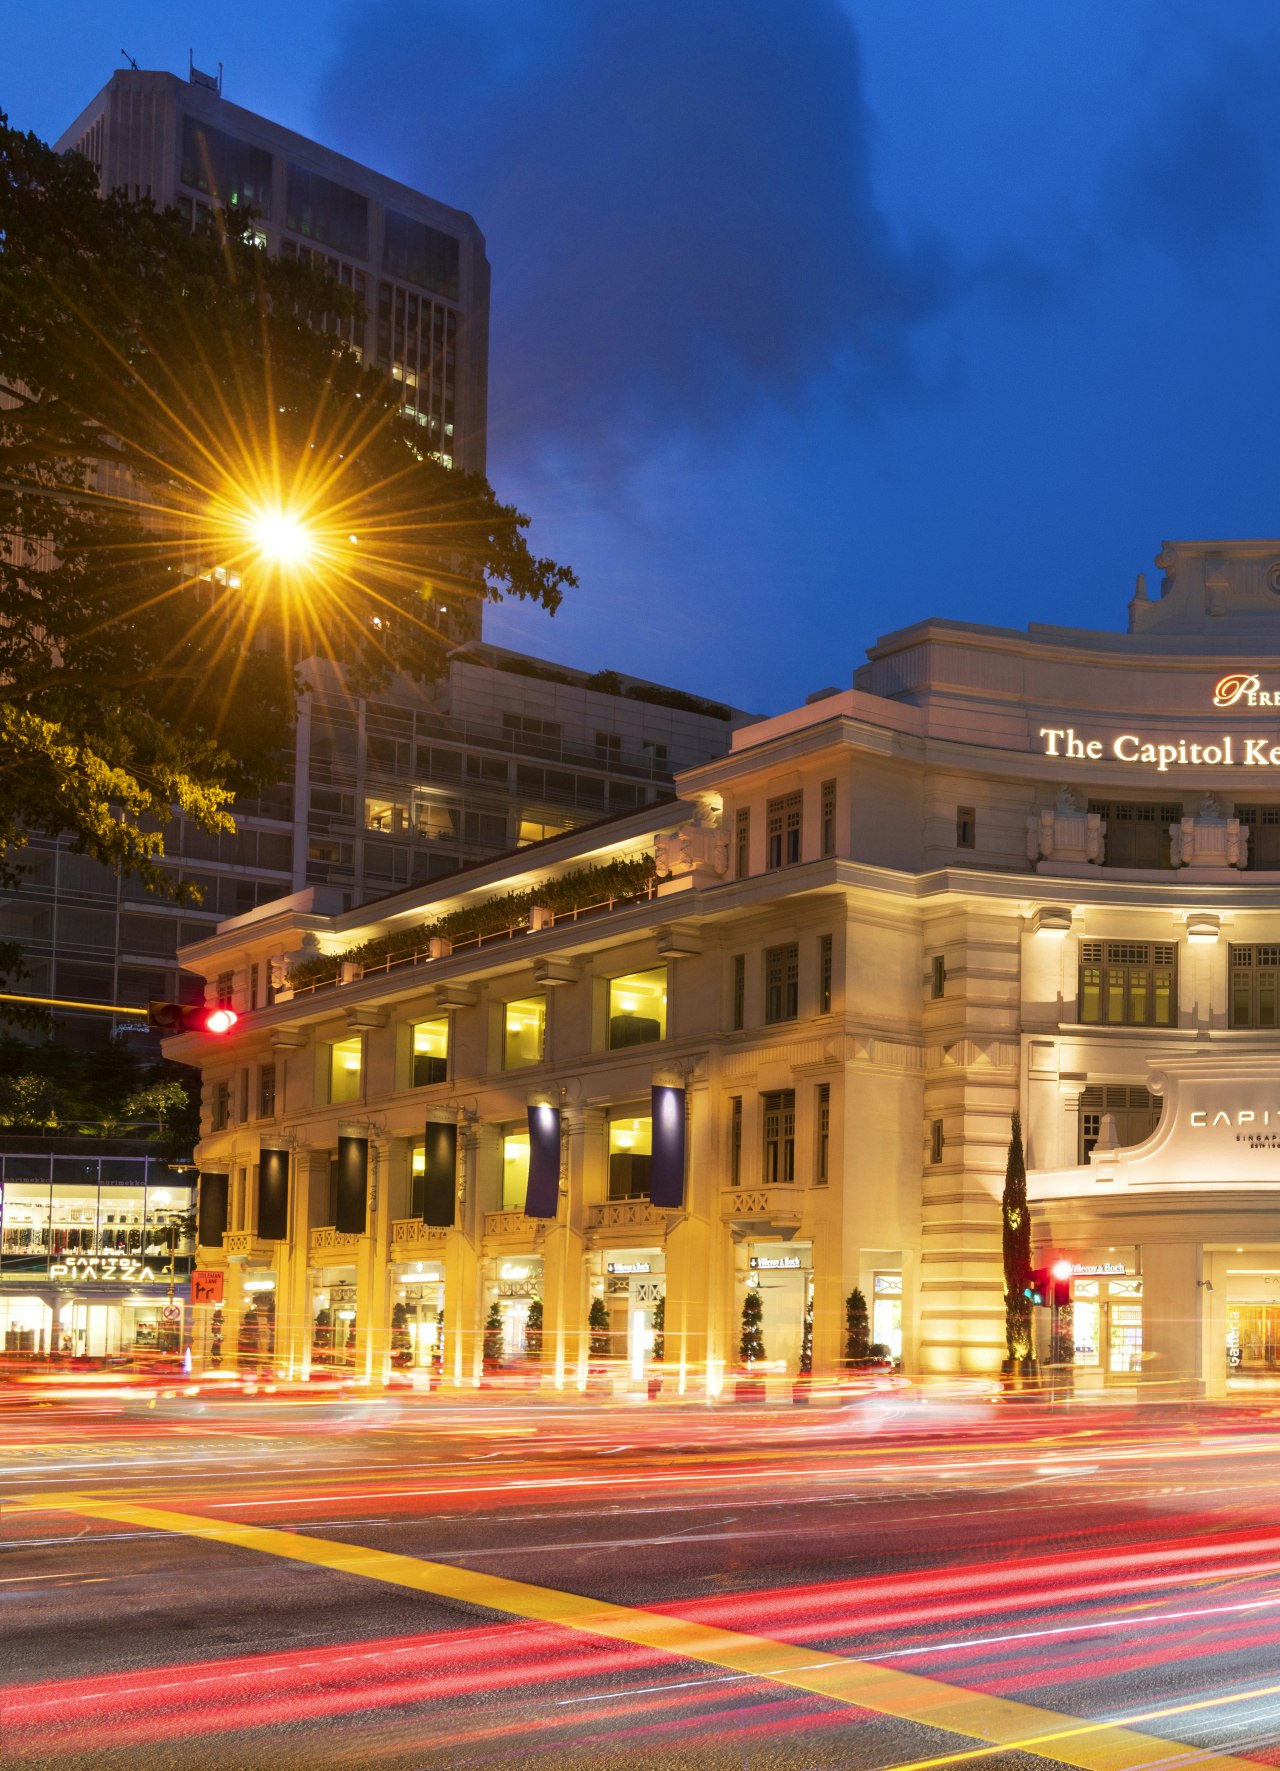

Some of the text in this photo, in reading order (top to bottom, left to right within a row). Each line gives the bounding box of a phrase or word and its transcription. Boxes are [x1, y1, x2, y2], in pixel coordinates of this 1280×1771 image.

[1039, 728, 1103, 760] The
[1113, 735, 1235, 771] Capitol
[65, 1257, 142, 1267] CAPITOL
[1097, 1264, 1104, 1272] &
[1105, 1262, 1124, 1272] Boch
[50, 1265, 155, 1280] PIAZZA
